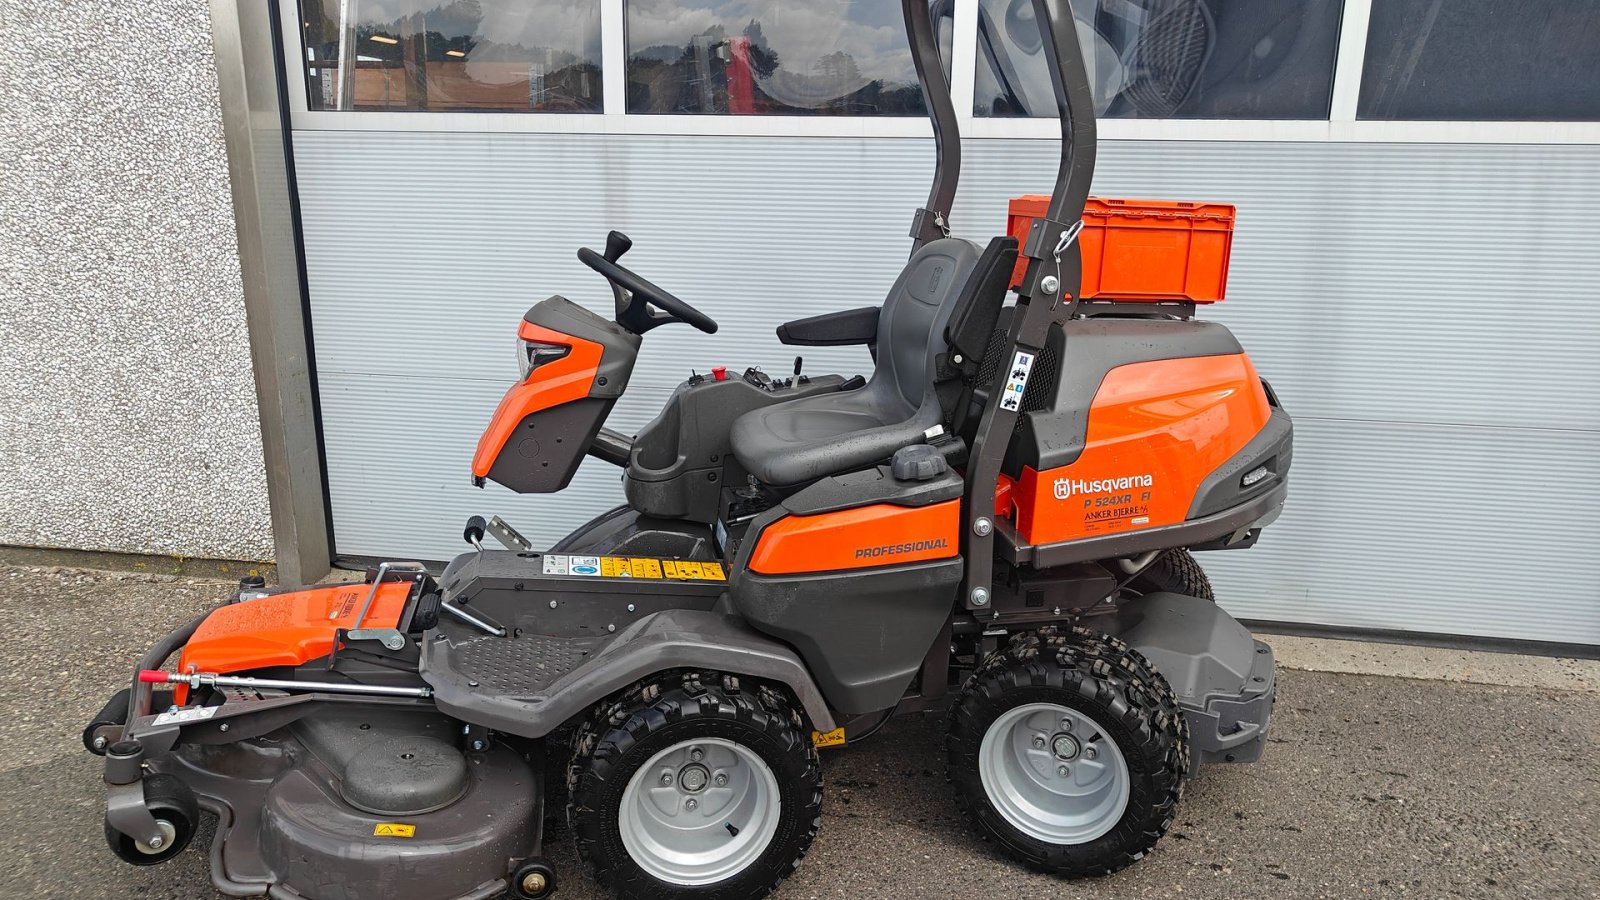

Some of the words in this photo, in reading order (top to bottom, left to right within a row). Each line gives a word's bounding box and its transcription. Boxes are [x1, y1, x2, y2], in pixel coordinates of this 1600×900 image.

[1072, 474, 1153, 495] Husqvarna
[1084, 499, 1092, 509] P
[1095, 494, 1131, 507] 524XR
[1084, 509, 1112, 521] ANKER
[1113, 506, 1139, 518] BJERRE
[855, 538, 948, 559] PROFESSIONAL
